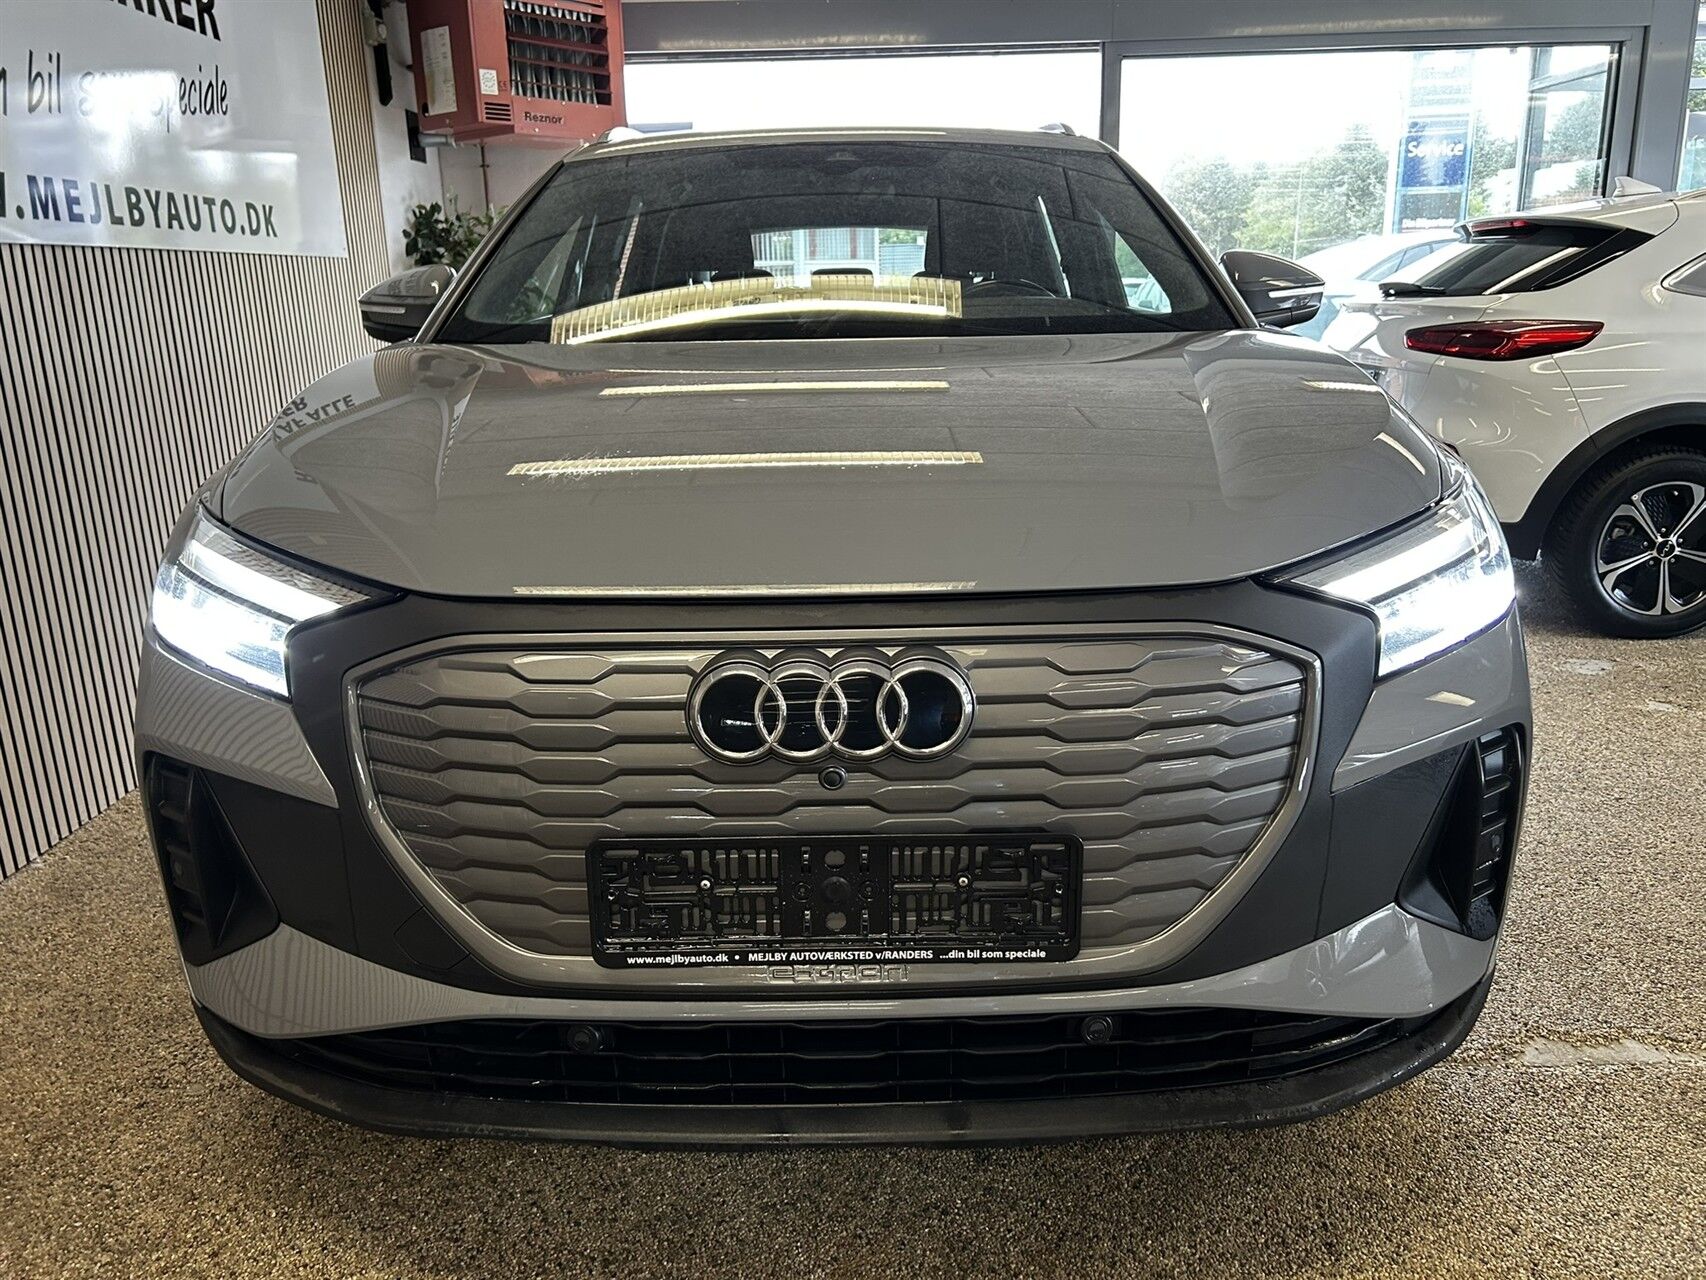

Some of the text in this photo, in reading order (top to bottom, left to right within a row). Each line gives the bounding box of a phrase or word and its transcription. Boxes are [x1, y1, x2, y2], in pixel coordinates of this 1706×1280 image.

[27, 50, 61, 114] bil
[524, 111, 563, 124] Reznor
[0, 171, 279, 239] .MEJLBYAUTO.DK
[626, 954, 729, 965] www.mejlbyauto.dk
[748, 952, 787, 961] MEJLBY
[789, 951, 874, 961] AUTOVÆRKSTED
[875, 950, 934, 960] v/RANDERS
[967, 950, 980, 959] bil
[981, 951, 1004, 959] som
[1004, 949, 1047, 960] speciale
